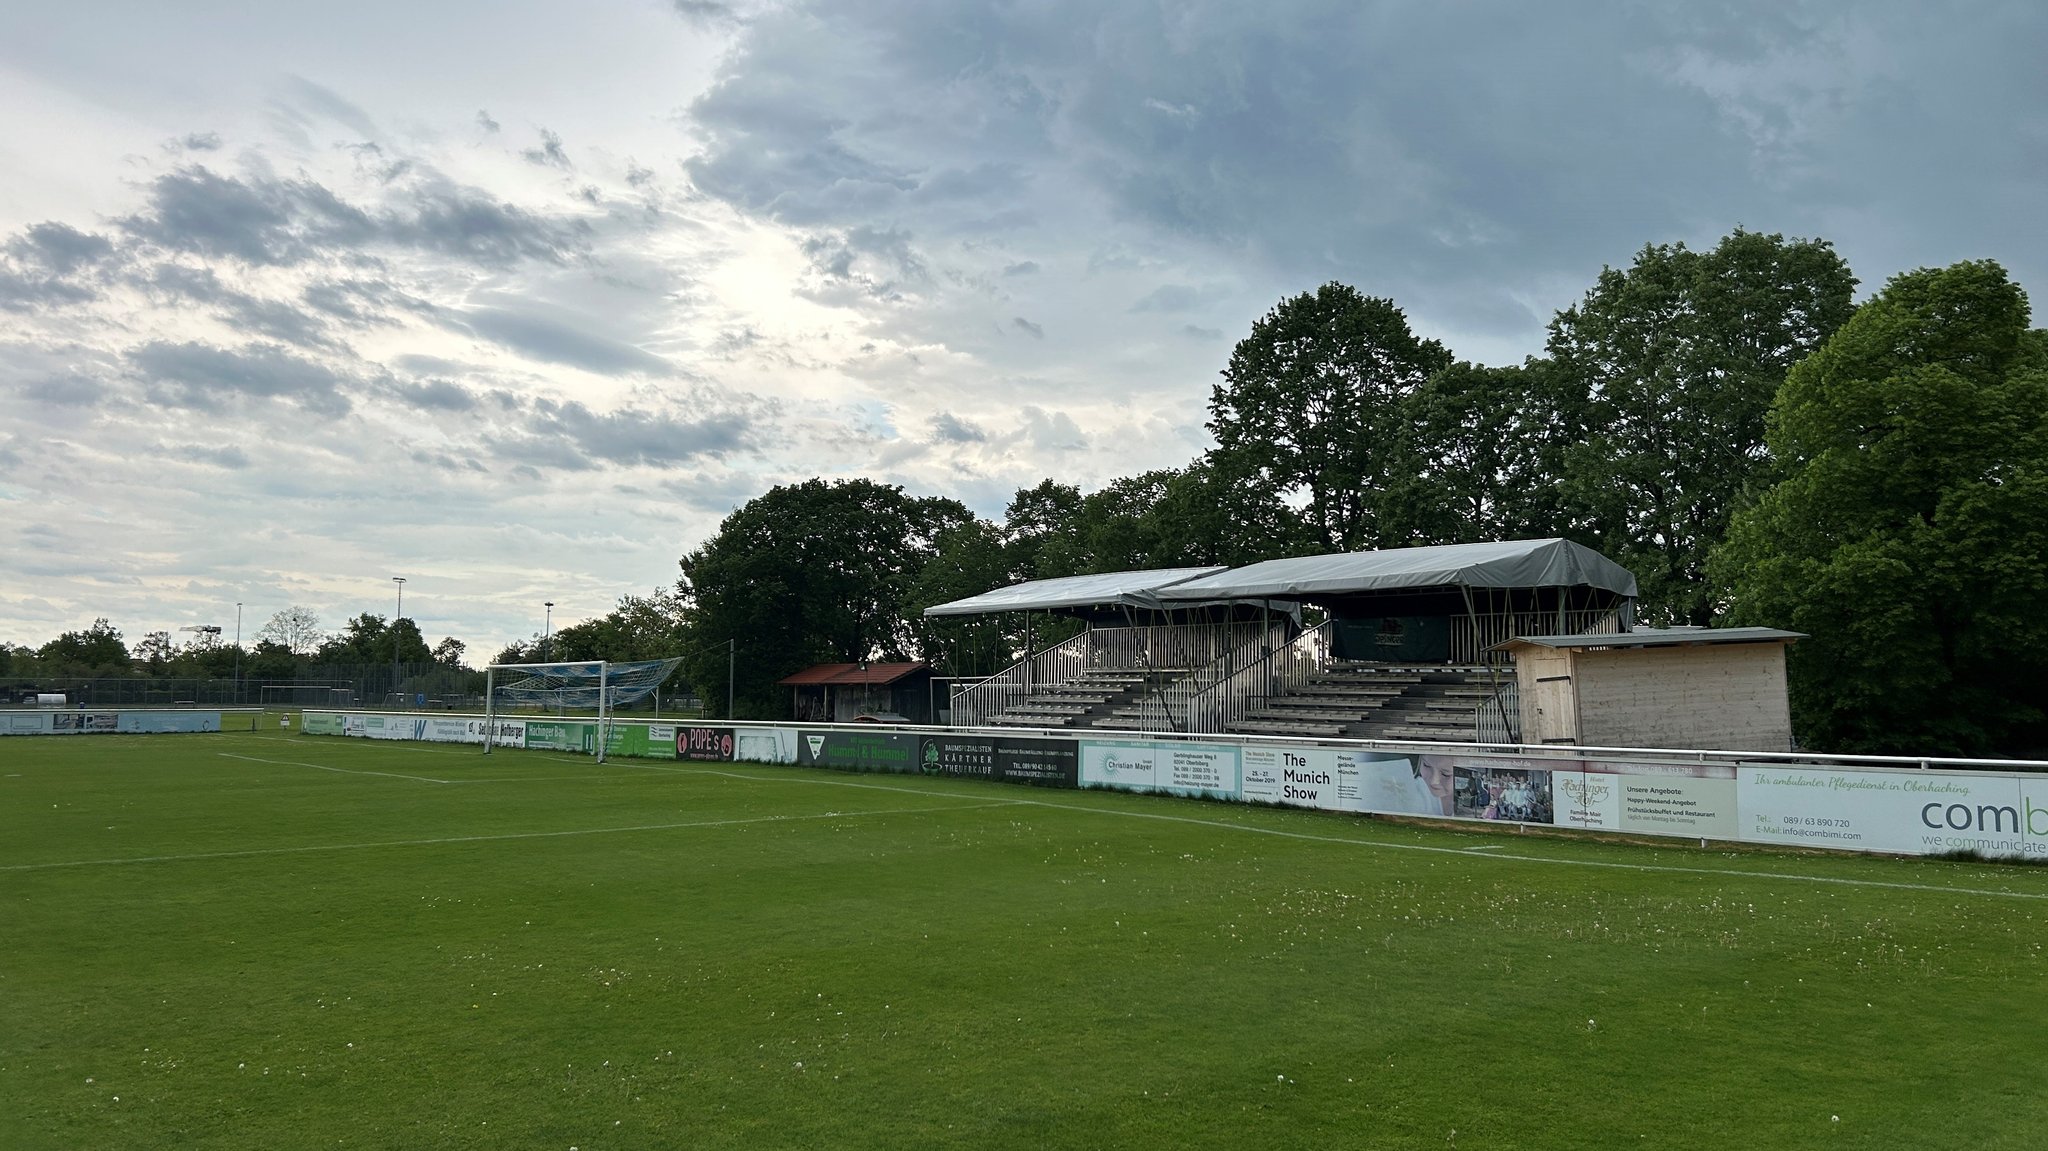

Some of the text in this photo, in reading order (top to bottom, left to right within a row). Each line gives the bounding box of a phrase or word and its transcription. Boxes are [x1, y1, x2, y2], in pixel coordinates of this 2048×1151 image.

[528, 724, 554, 740] Hachinger
[690, 728, 719, 751] POPE's
[828, 743, 909, 761] Hummel & Hummel
[944, 744, 992, 753] BAUMSPEZIALISTEN
[1108, 761, 1152, 771] Christian Mayer
[1283, 753, 1306, 767] The
[944, 764, 992, 775] THEUERKAUF
[1284, 769, 1330, 784] Munich
[1754, 773, 1771, 785] Ihr
[1773, 775, 1824, 787] ambulanter
[1828, 777, 1887, 791] Pflegedienst
[1889, 782, 1901, 791] in
[1284, 785, 1318, 800] Show
[1627, 786, 1649, 794] Unsere
[1627, 806, 1672, 815] Frühstücksbuffet
[1685, 810, 1716, 818] Restaurant
[1569, 816, 1603, 825] Oberhaching
[1783, 816, 1799, 825] 089
[1804, 818, 1816, 826] 63
[1816, 819, 1833, 827] 890
[1834, 819, 1850, 828] 720
[1755, 825, 1862, 841] E-Mail: info@combimi.com
[1921, 835, 2046, 854] we communicate
